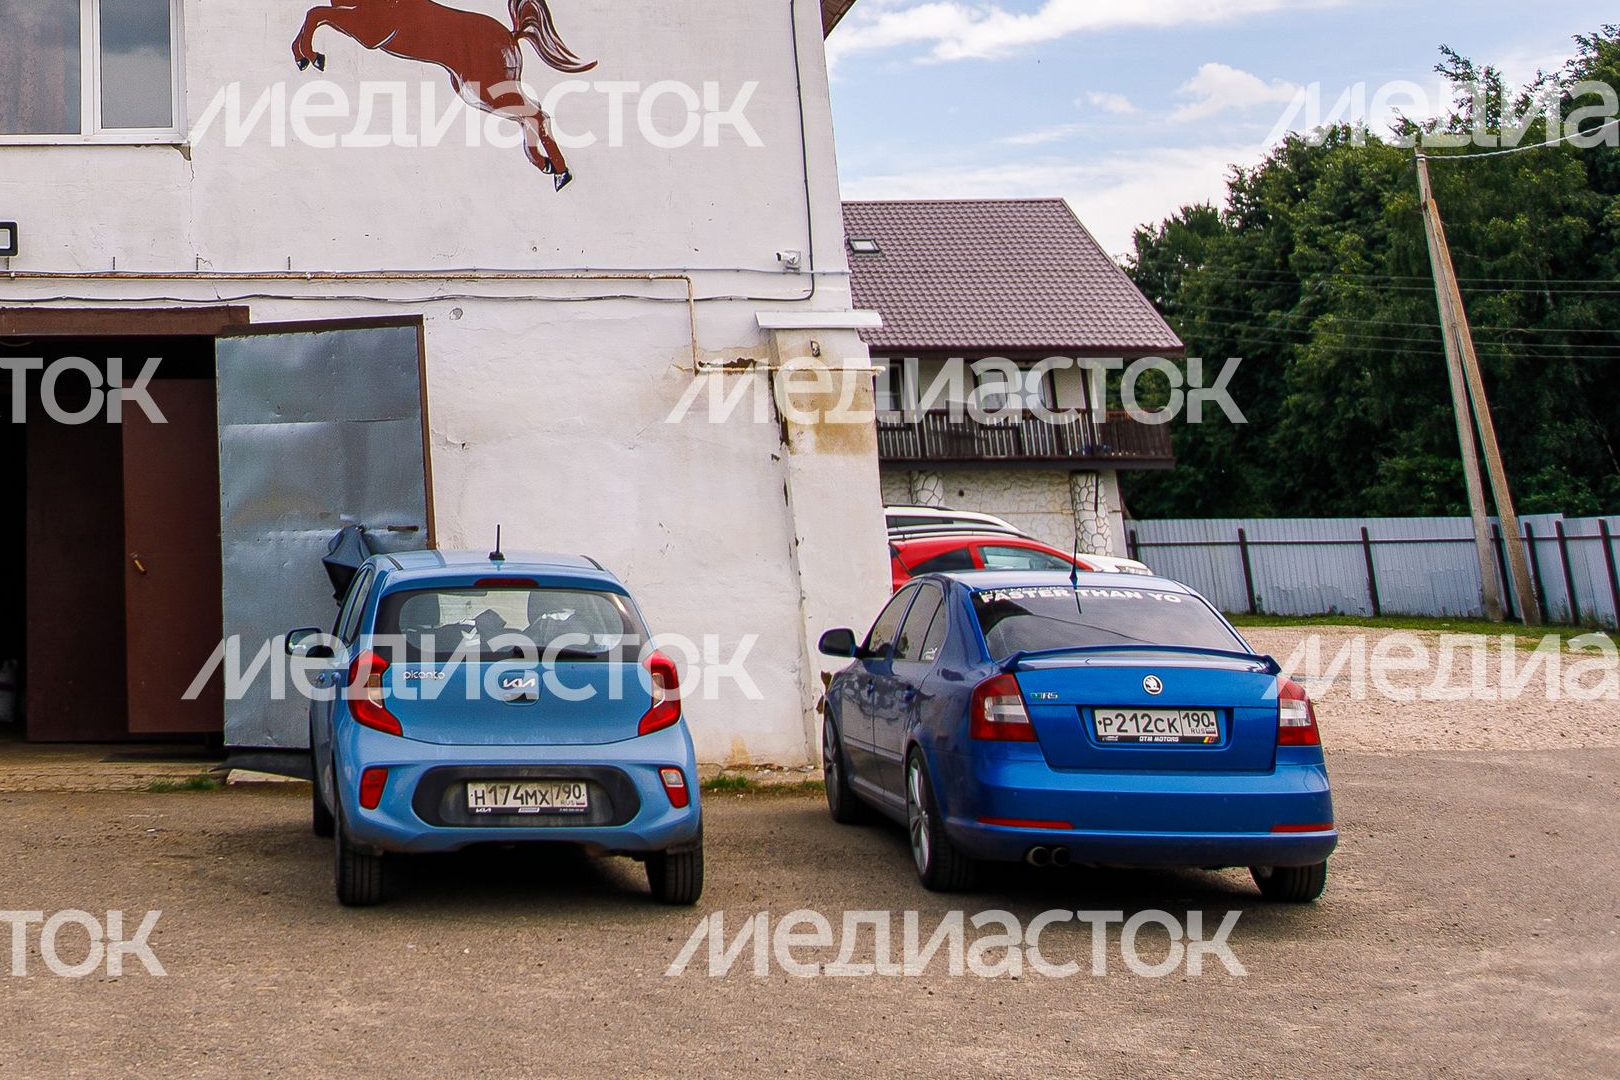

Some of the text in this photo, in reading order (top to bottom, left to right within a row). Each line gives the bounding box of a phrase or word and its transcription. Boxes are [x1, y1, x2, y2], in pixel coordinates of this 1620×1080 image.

[980, 589, 1071, 604] FASTER
[1075, 589, 1144, 600] THAN
[402, 670, 446, 681] picanto
[503, 677, 536, 688] KIA
